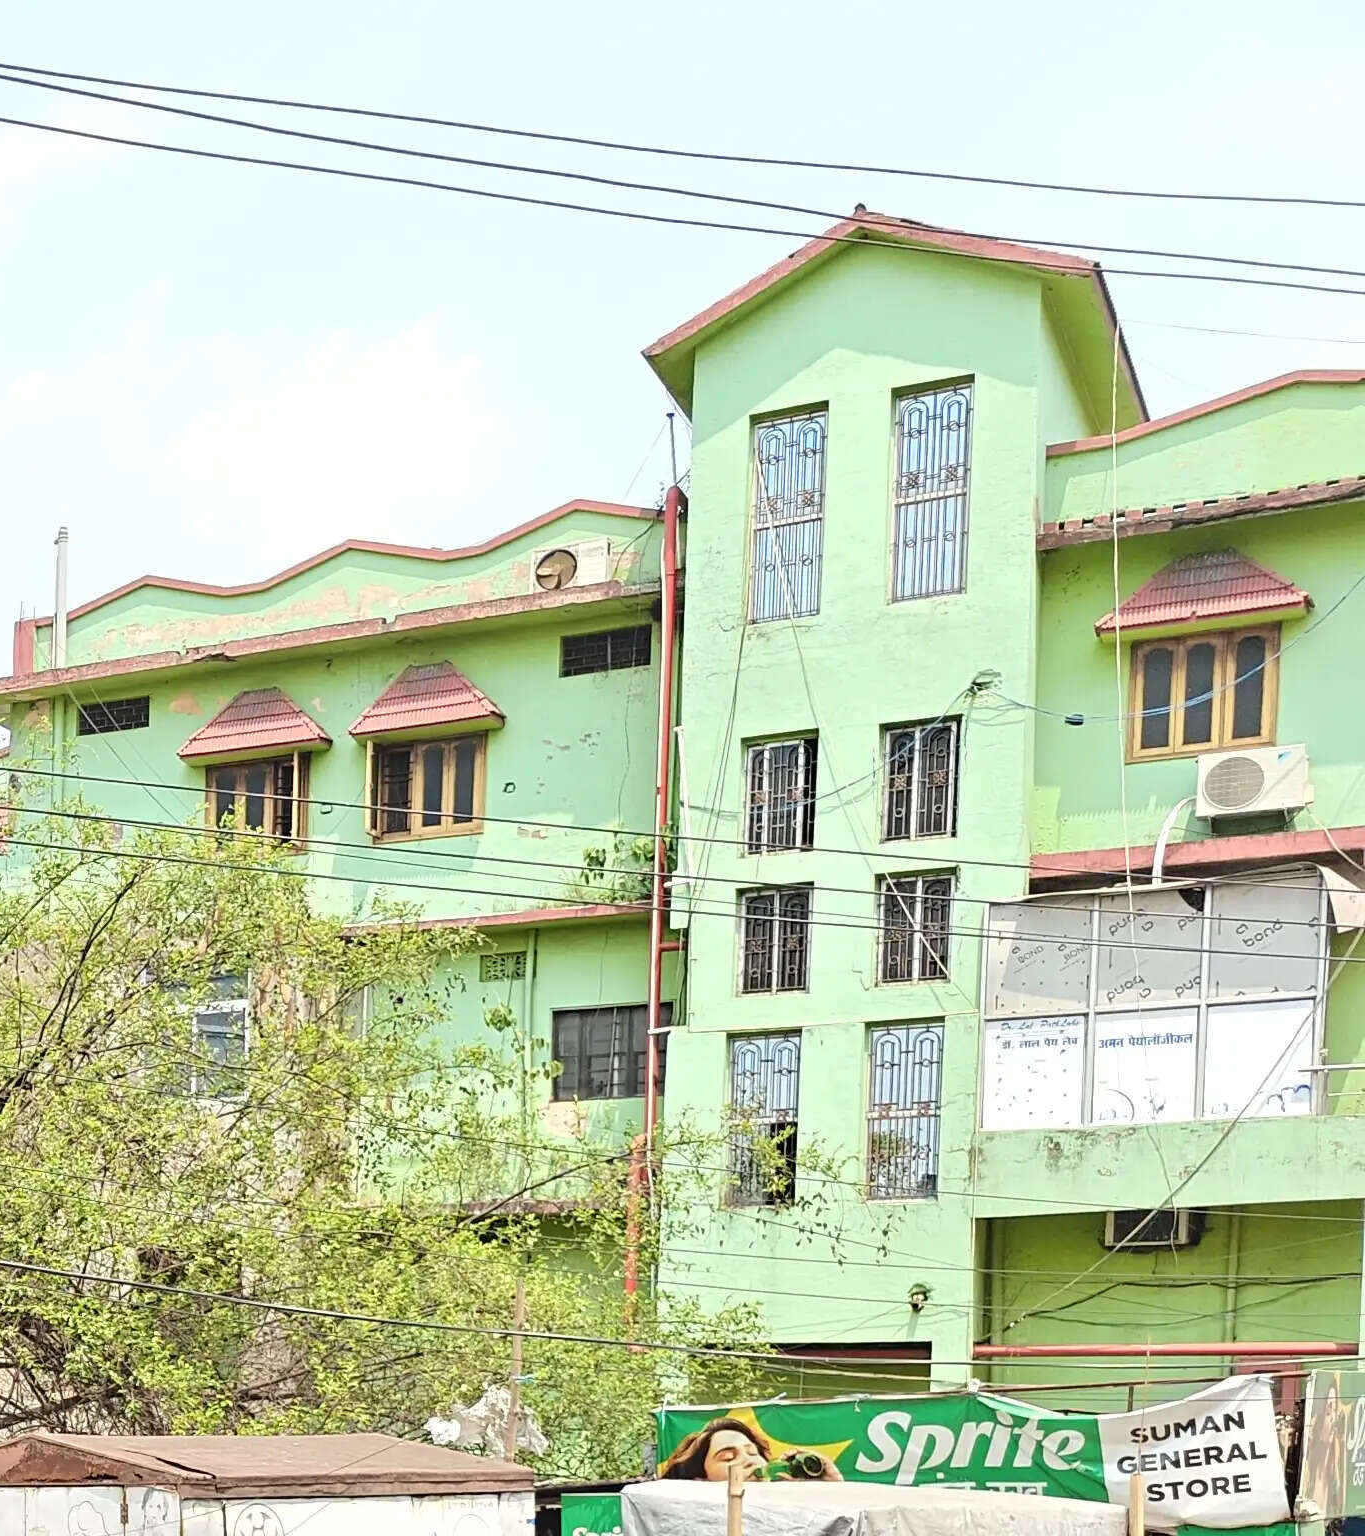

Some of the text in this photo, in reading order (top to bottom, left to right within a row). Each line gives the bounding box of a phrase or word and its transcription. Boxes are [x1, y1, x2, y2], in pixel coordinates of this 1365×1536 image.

[1098, 1037, 1124, 1049] अमन
[1130, 1410, 1245, 1444] SUMAN
[854, 1409, 1086, 1486] Sprite
[1117, 1441, 1268, 1475] GENERAL
[1146, 1474, 1252, 1502] STORE
